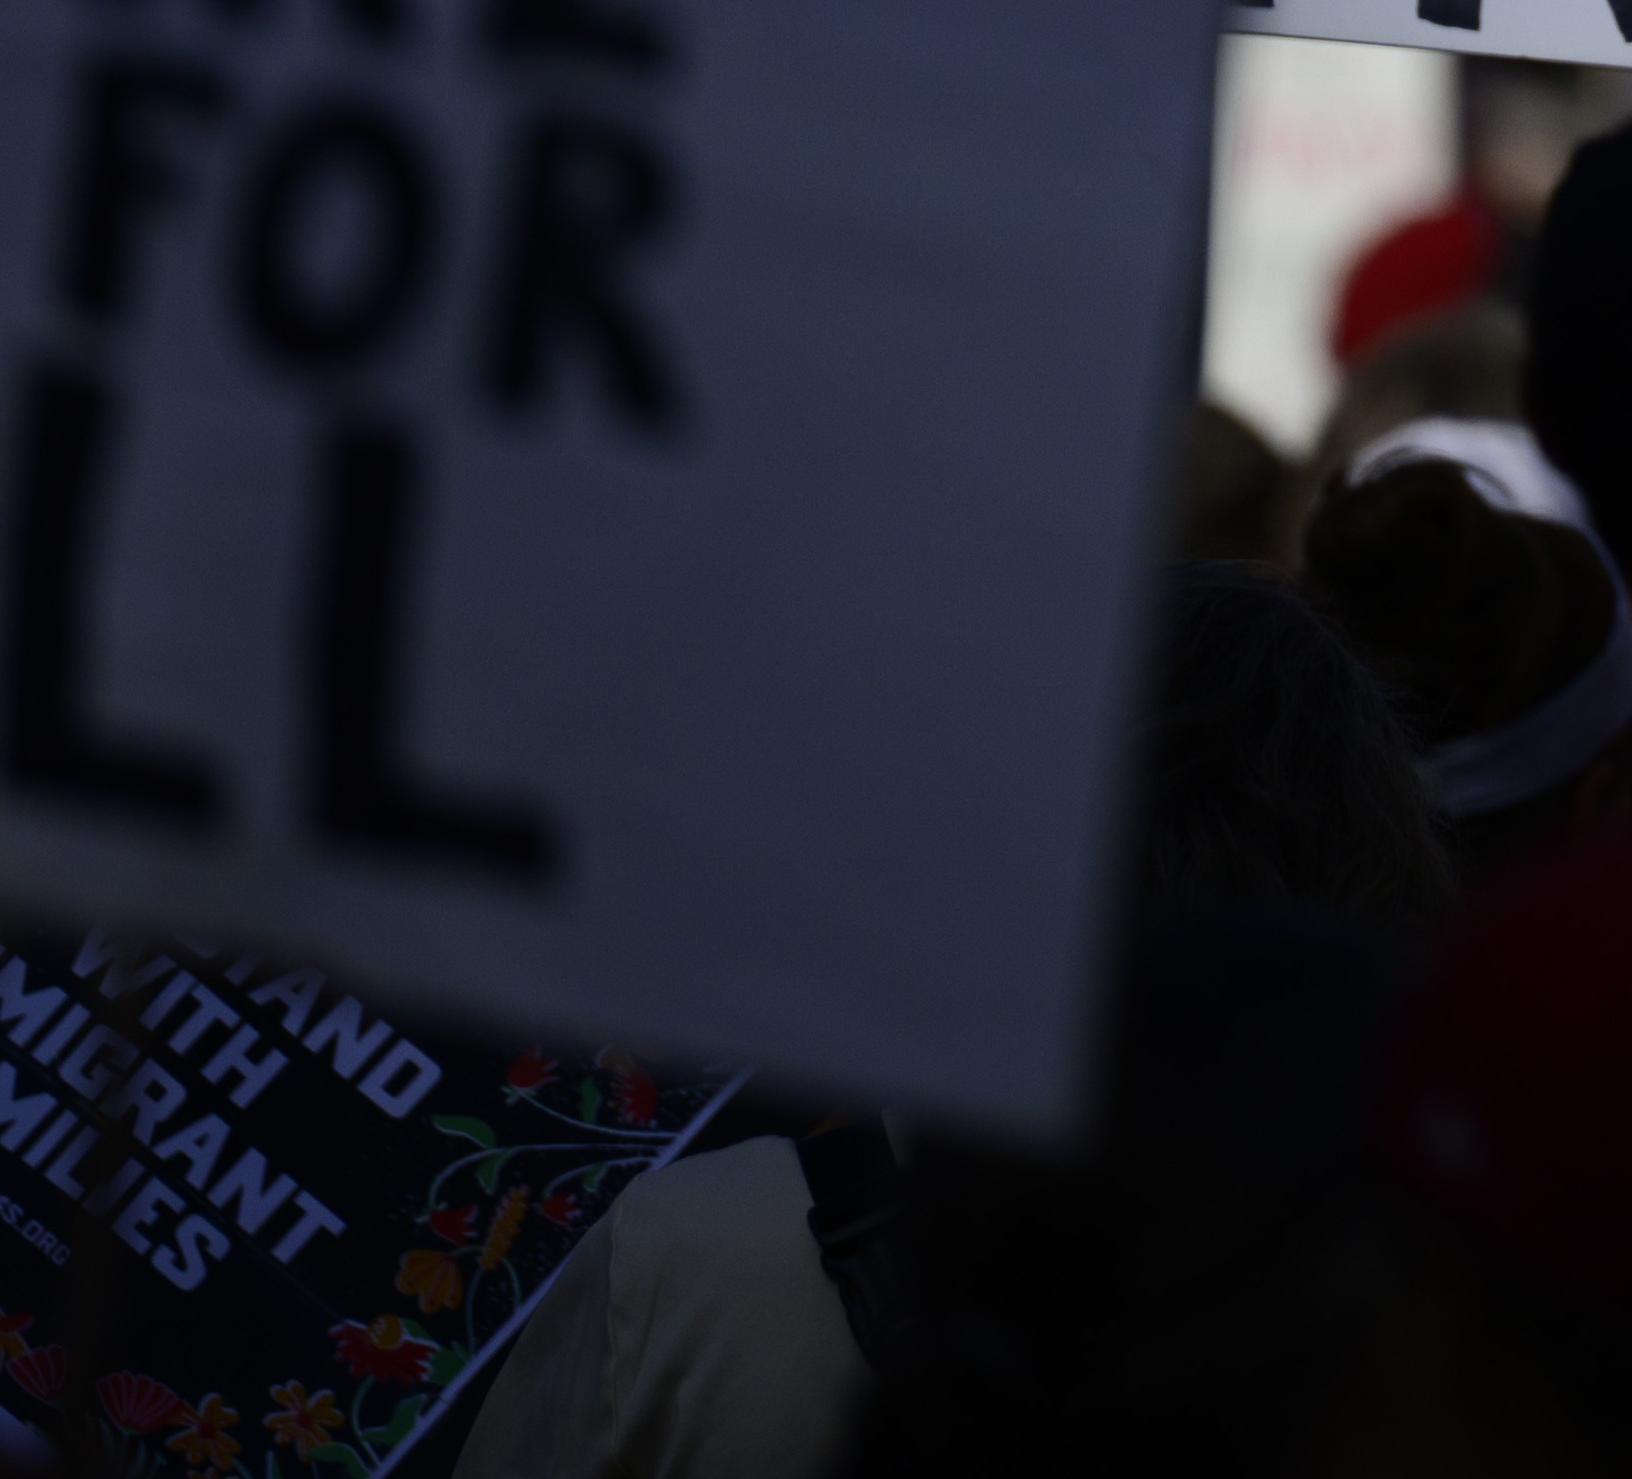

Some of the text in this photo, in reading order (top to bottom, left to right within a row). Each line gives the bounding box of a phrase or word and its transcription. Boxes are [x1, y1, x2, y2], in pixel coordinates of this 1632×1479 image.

[70, 55, 688, 438] FOR
[0, 944, 348, 1265] MIGRANT
[70, 920, 290, 1110] WITH
